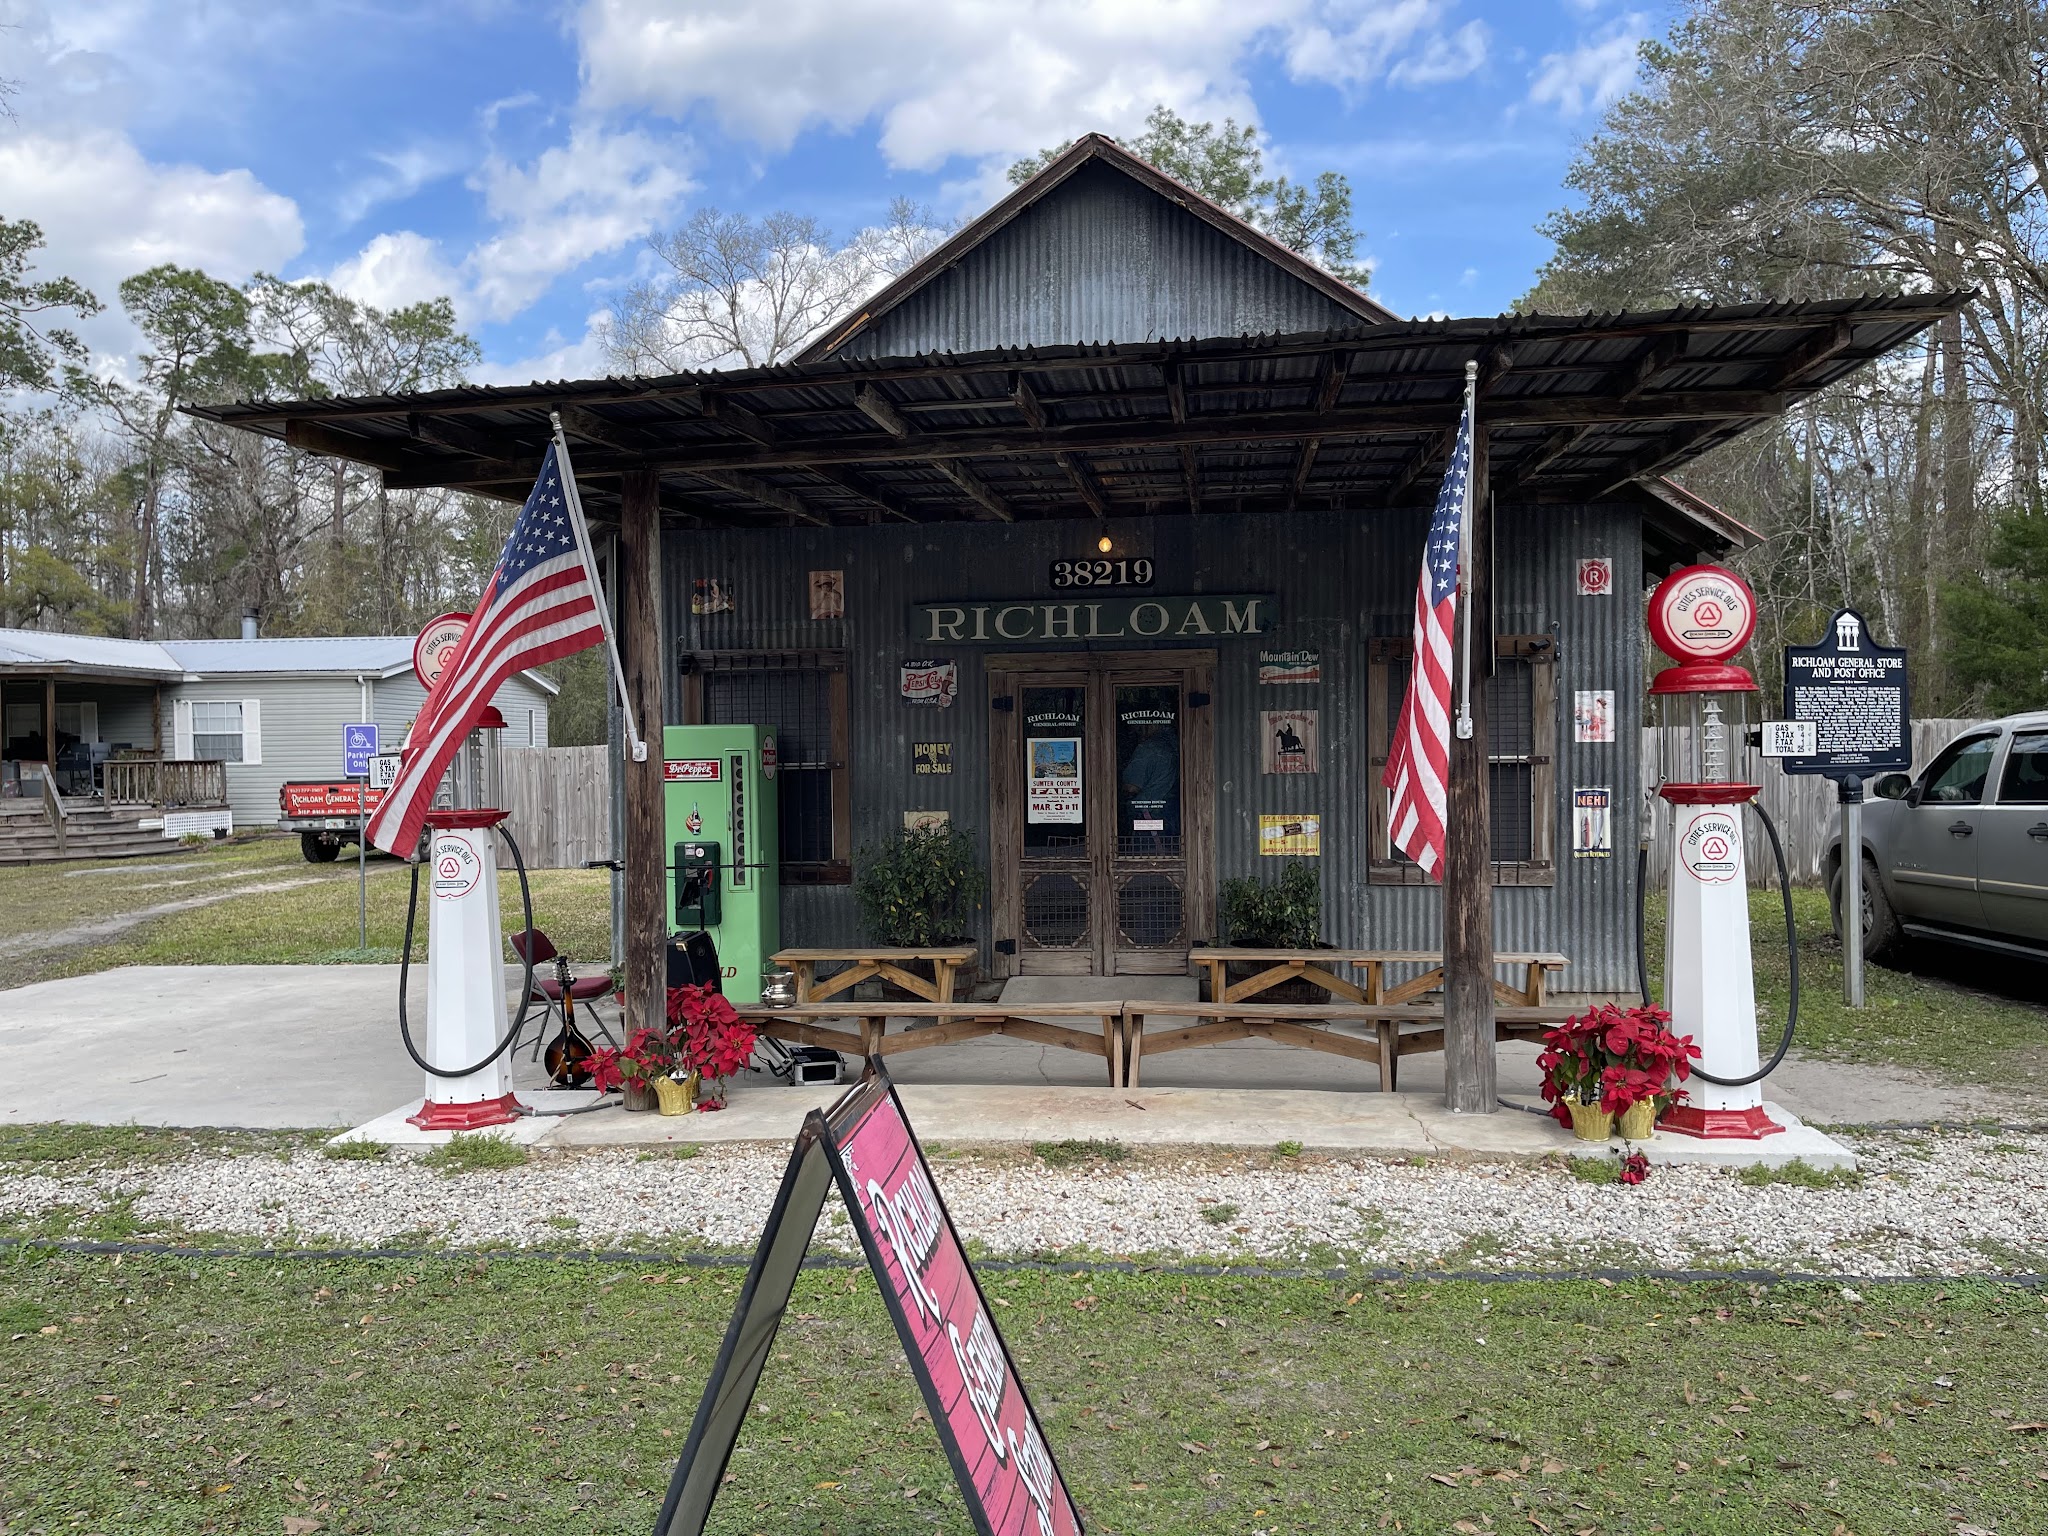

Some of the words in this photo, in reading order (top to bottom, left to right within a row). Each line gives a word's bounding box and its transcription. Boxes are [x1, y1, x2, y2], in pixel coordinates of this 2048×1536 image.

[1054, 560, 1153, 586] 38219
[1590, 571, 1599, 583] R
[1677, 592, 1697, 612] CITIES
[1695, 587, 1727, 600] SERVICE
[1723, 595, 1738, 611] OILS
[925, 600, 1263, 641] RICHLOAM
[426, 636, 441, 656] CITIES
[440, 632, 462, 643] SERVIC
[1259, 651, 1299, 662] Mountain
[1299, 650, 1319, 662] Dew
[1791, 657, 1835, 668] RICHLOAM
[1838, 658, 1874, 668] GENERAL
[1877, 658, 1902, 669] STORE
[1812, 668, 1831, 678] AND
[1834, 668, 1856, 678] POST
[1858, 668, 1886, 678] OFFICE
[1027, 713, 1080, 723] RICHLOAM
[1121, 710, 1175, 721] RICHLOAM
[347, 751, 375, 759] Parking
[914, 743, 951, 758] HONEY
[1797, 745, 1804, 753] 25
[353, 760, 369, 769] Only
[681, 763, 712, 776] Pepper
[915, 764, 930, 774] FOR
[931, 764, 952, 774] SALE
[291, 793, 324, 807] RICHLOAM
[325, 793, 355, 805] GENERAL
[1577, 795, 1607, 806] NEHI
[1055, 803, 1063, 811] 3
[1072, 803, 1079, 811] 11
[1688, 826, 1705, 846] CITIES
[1703, 822, 1731, 835] SERVICE
[1729, 831, 1737, 845] OILS
[440, 844, 464, 856] SERVICE
[461, 851, 473, 865] OILS
